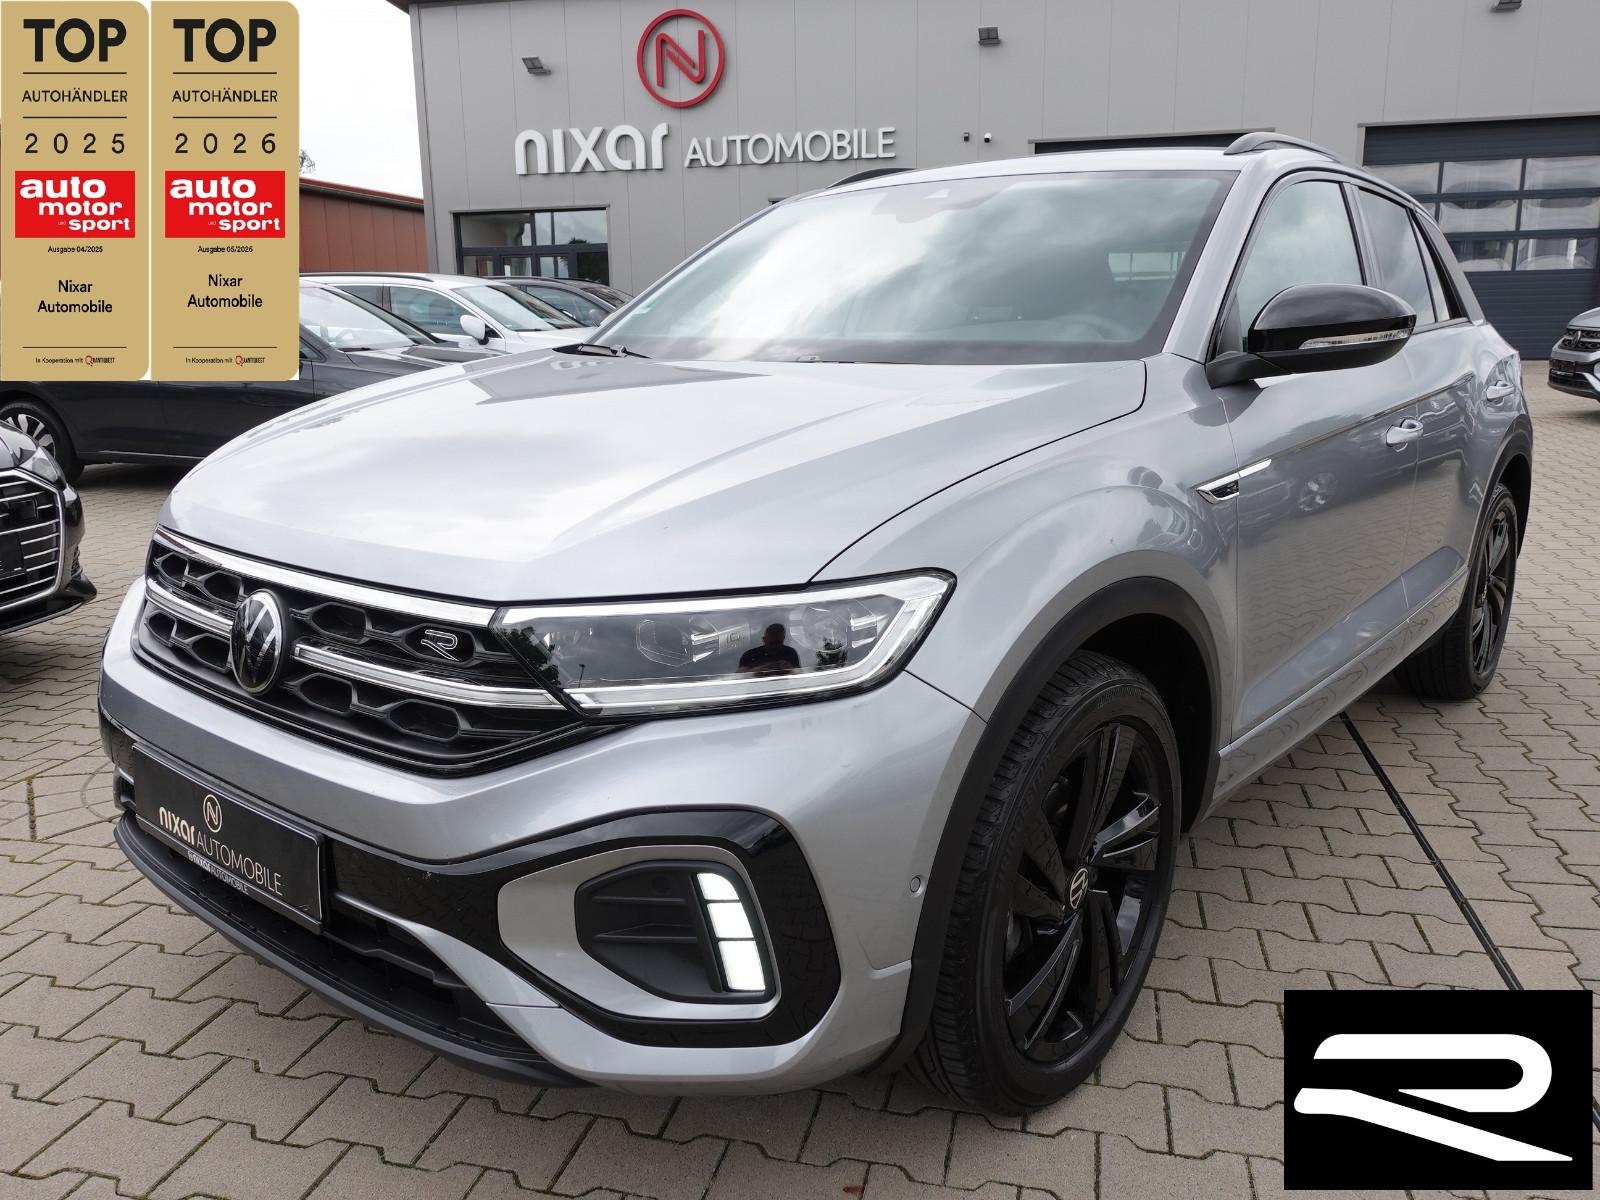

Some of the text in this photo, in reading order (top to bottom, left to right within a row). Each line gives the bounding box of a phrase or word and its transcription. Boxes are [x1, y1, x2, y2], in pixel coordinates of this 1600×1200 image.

[514, 122, 897, 175] nixar AUTOMOBILE
[158, 806, 284, 897] nixar AUTOMOBILE
